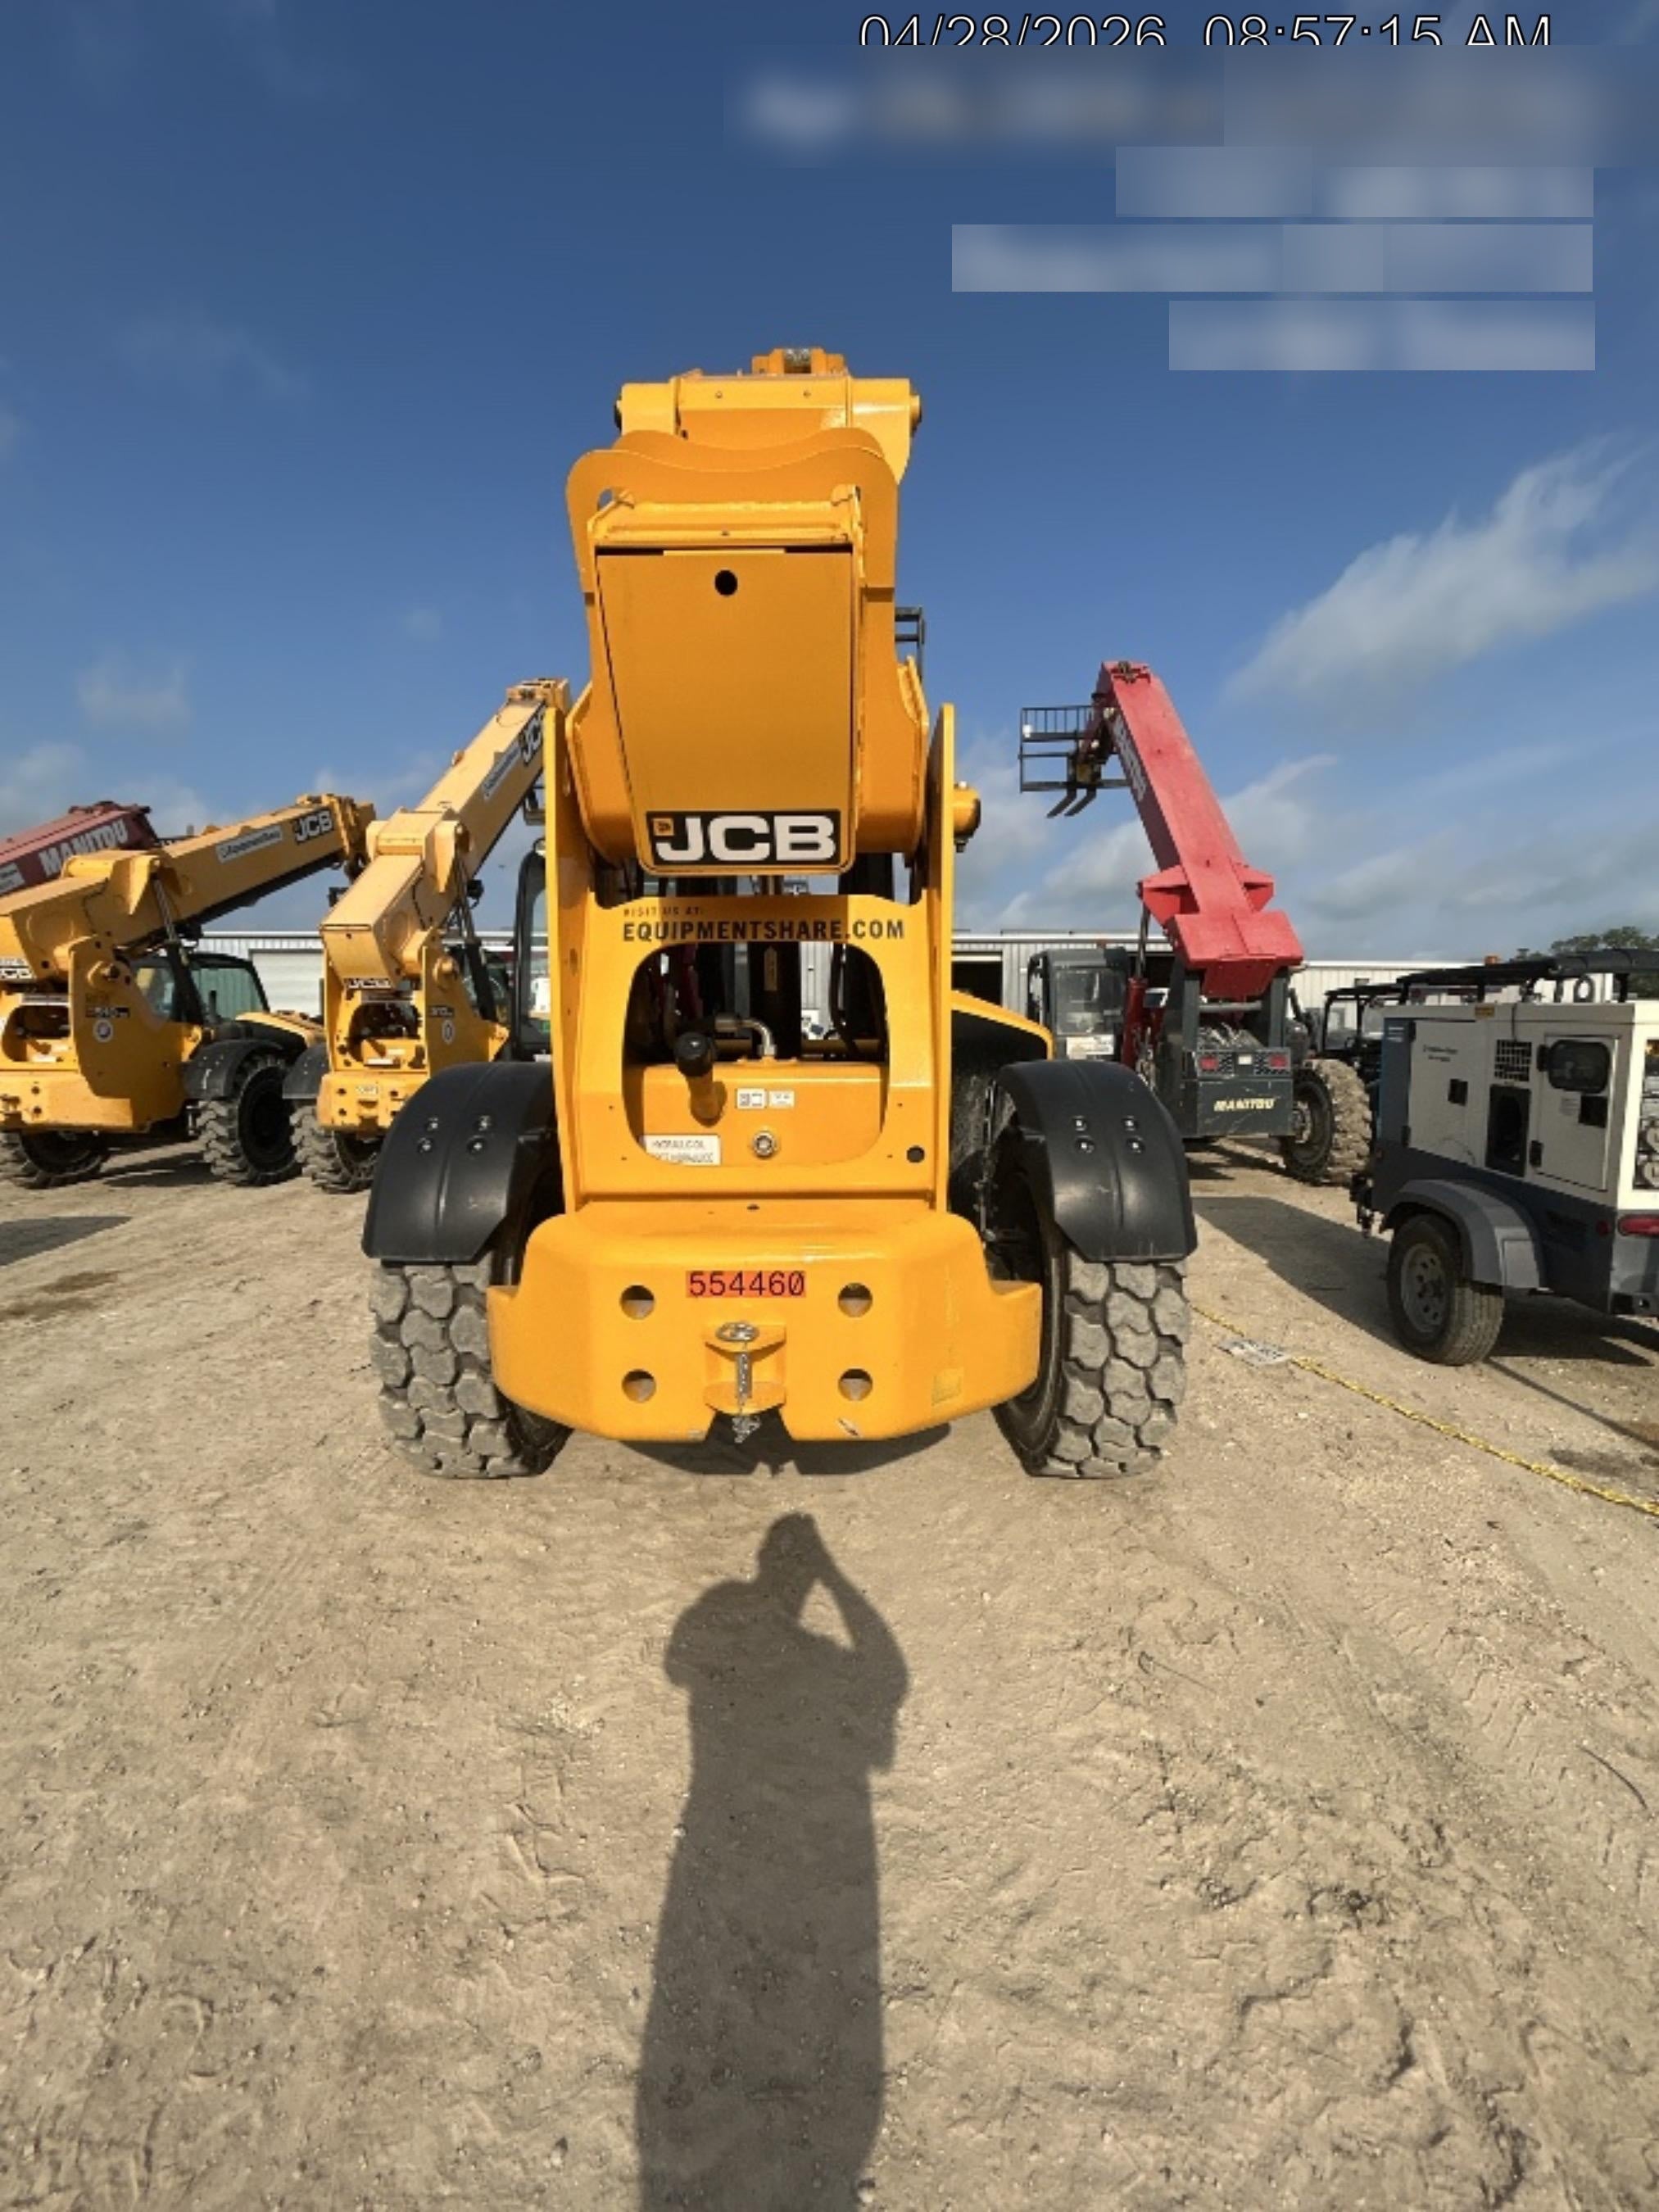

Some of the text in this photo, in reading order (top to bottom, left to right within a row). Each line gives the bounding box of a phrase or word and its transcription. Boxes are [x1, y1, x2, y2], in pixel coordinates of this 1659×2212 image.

[523, 705, 544, 764] JC
[295, 809, 332, 841] JCB
[655, 816, 836, 860] JCB
[39, 819, 128, 877] MANITOU
[623, 918, 904, 941] EQUIPMENTSHARE.COM
[1213, 1098, 1275, 1112] MANITOU
[690, 1271, 805, 1296] 554460
